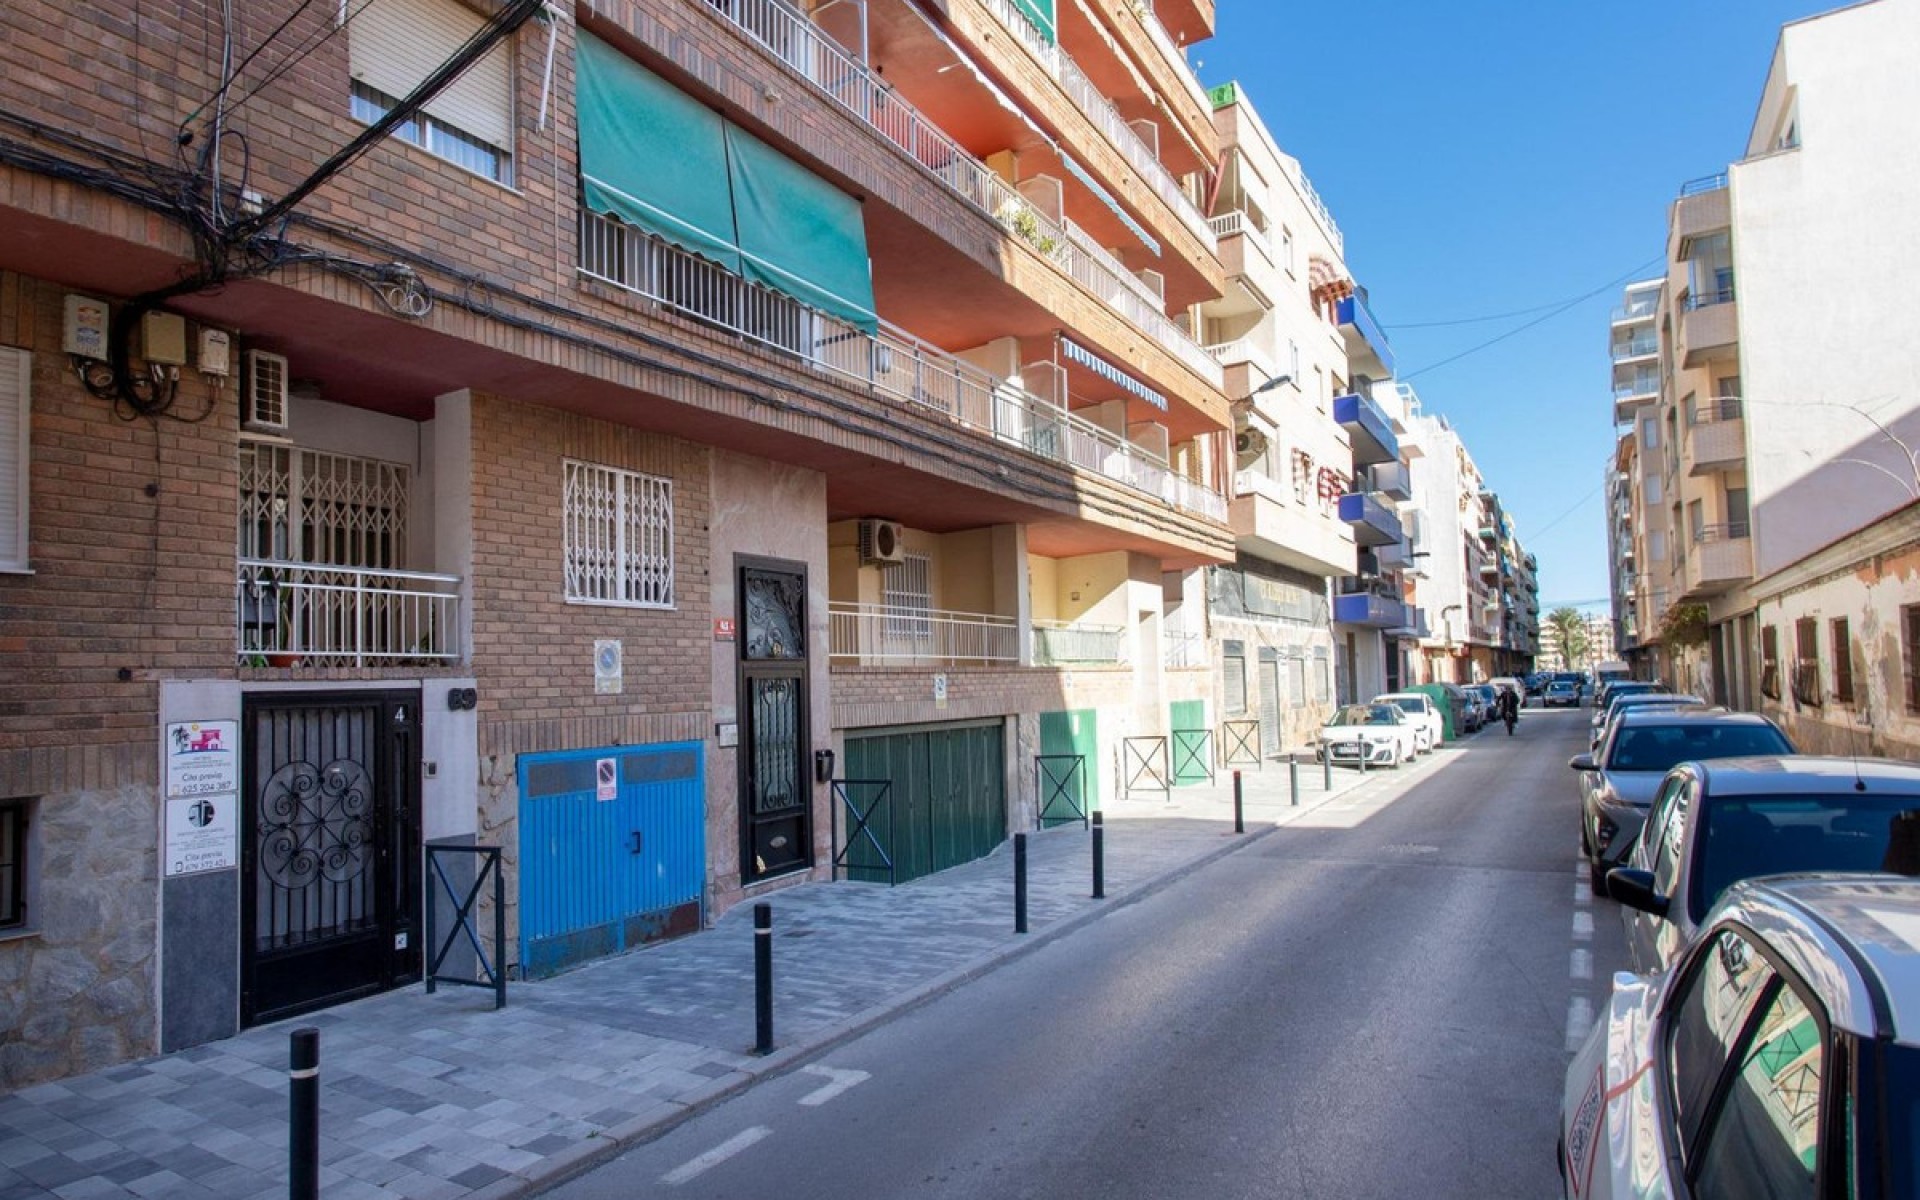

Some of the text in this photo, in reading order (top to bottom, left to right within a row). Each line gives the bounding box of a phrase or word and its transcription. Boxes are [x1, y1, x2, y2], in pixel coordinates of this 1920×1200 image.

[394, 705, 405, 723] 4
[182, 770, 223, 782] Cita previa
[185, 853, 199, 862] Cita
